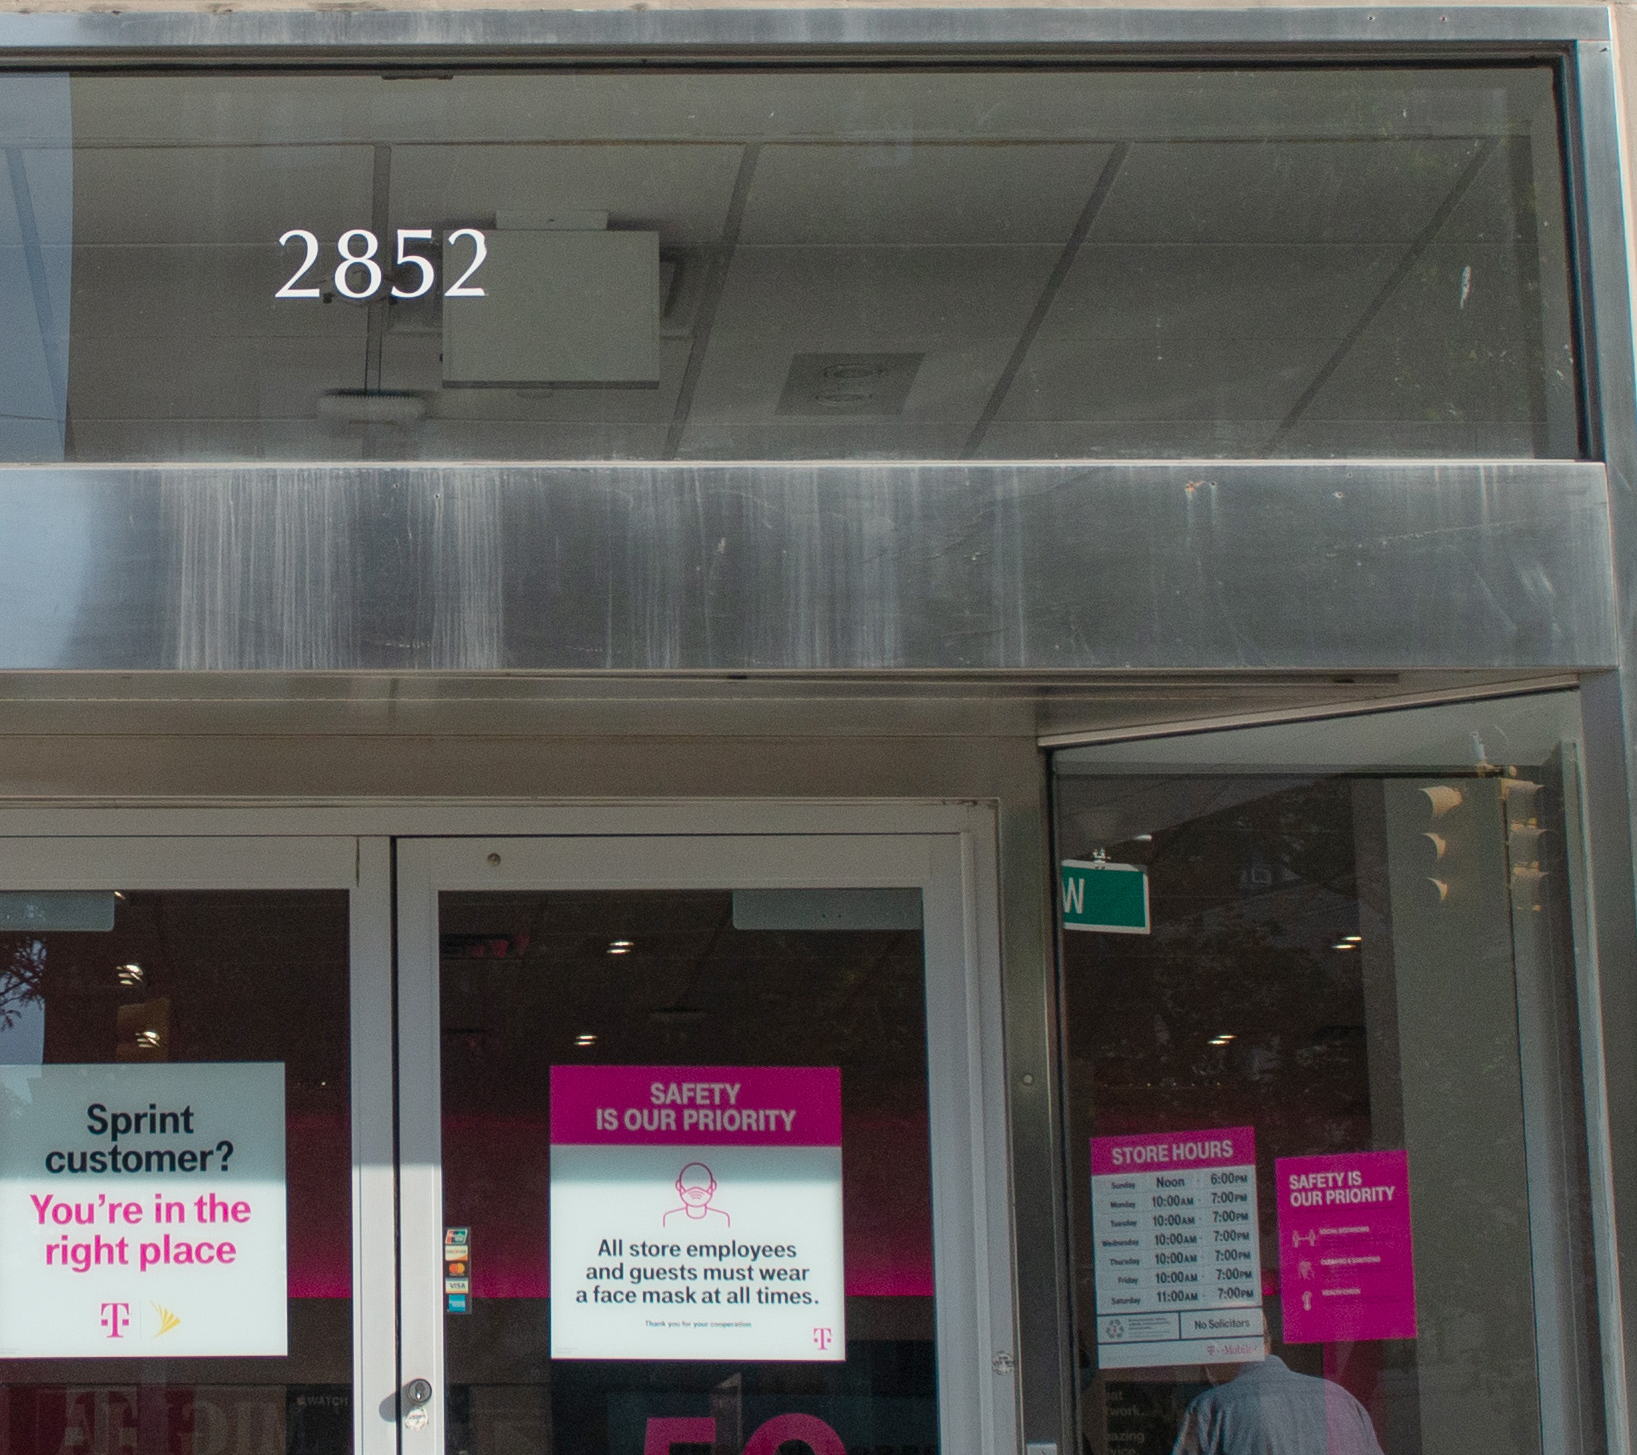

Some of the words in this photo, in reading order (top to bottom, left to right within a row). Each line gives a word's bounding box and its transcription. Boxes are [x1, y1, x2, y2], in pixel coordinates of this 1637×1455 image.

[275, 228, 487, 298] 2852
[650, 1082, 740, 1105] SAFETY
[87, 1103, 194, 1141] Sprint
[596, 1109, 618, 1130] IS
[625, 1109, 677, 1131] OUR
[683, 1109, 796, 1132] PRIORITY
[45, 1140, 233, 1173] customer?
[1112, 1145, 1168, 1165] STORE
[1173, 1140, 1233, 1160] HOURS
[1156, 1177, 1185, 1188] Noon
[1289, 1172, 1345, 1190] SAFETY
[1348, 1171, 1362, 1185] IS
[1291, 1192, 1322, 1207] OUR
[1326, 1186, 1395, 1205] PRIORITY
[30, 1194, 143, 1225] You’re
[155, 1193, 185, 1223] in
[194, 1193, 251, 1223] the
[46, 1234, 128, 1273] right
[140, 1234, 236, 1272] place
[598, 1239, 623, 1257] All
[629, 1240, 681, 1257] store
[686, 1240, 797, 1262] employees
[586, 1262, 624, 1280] and
[630, 1265, 697, 1284] guests
[703, 1265, 754, 1281] must
[759, 1267, 809, 1281] wear
[576, 1288, 587, 1303] a
[593, 1286, 636, 1303] face
[643, 1286, 696, 1304] mask
[701, 1288, 721, 1304] at
[727, 1286, 750, 1304] all
[756, 1287, 819, 1305] times.
[1195, 1320, 1207, 1330] No
[1209, 1319, 1250, 1329] Solicitors
